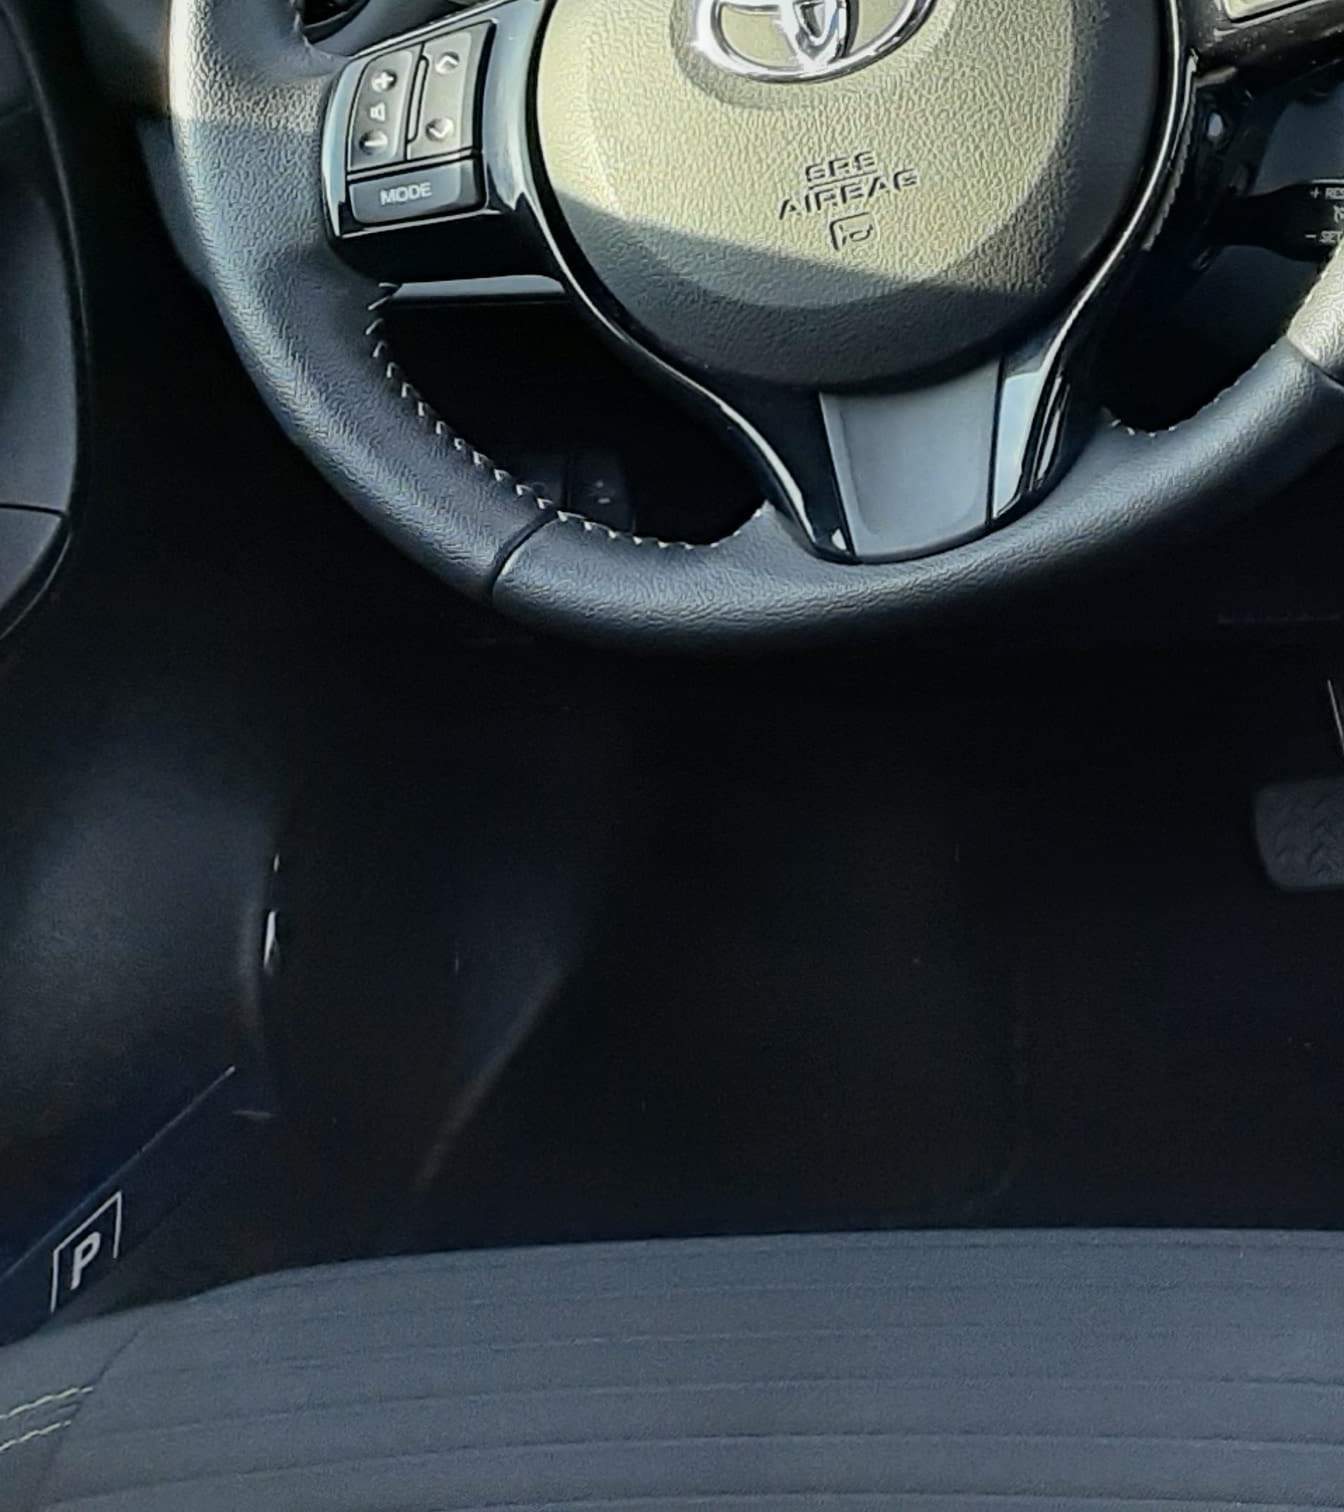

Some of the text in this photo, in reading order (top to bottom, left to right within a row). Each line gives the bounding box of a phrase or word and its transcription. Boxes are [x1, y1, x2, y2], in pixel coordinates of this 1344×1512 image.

[380, 181, 432, 206] MODE
[779, 168, 918, 220] AIRBAG
[69, 1231, 101, 1291] P
